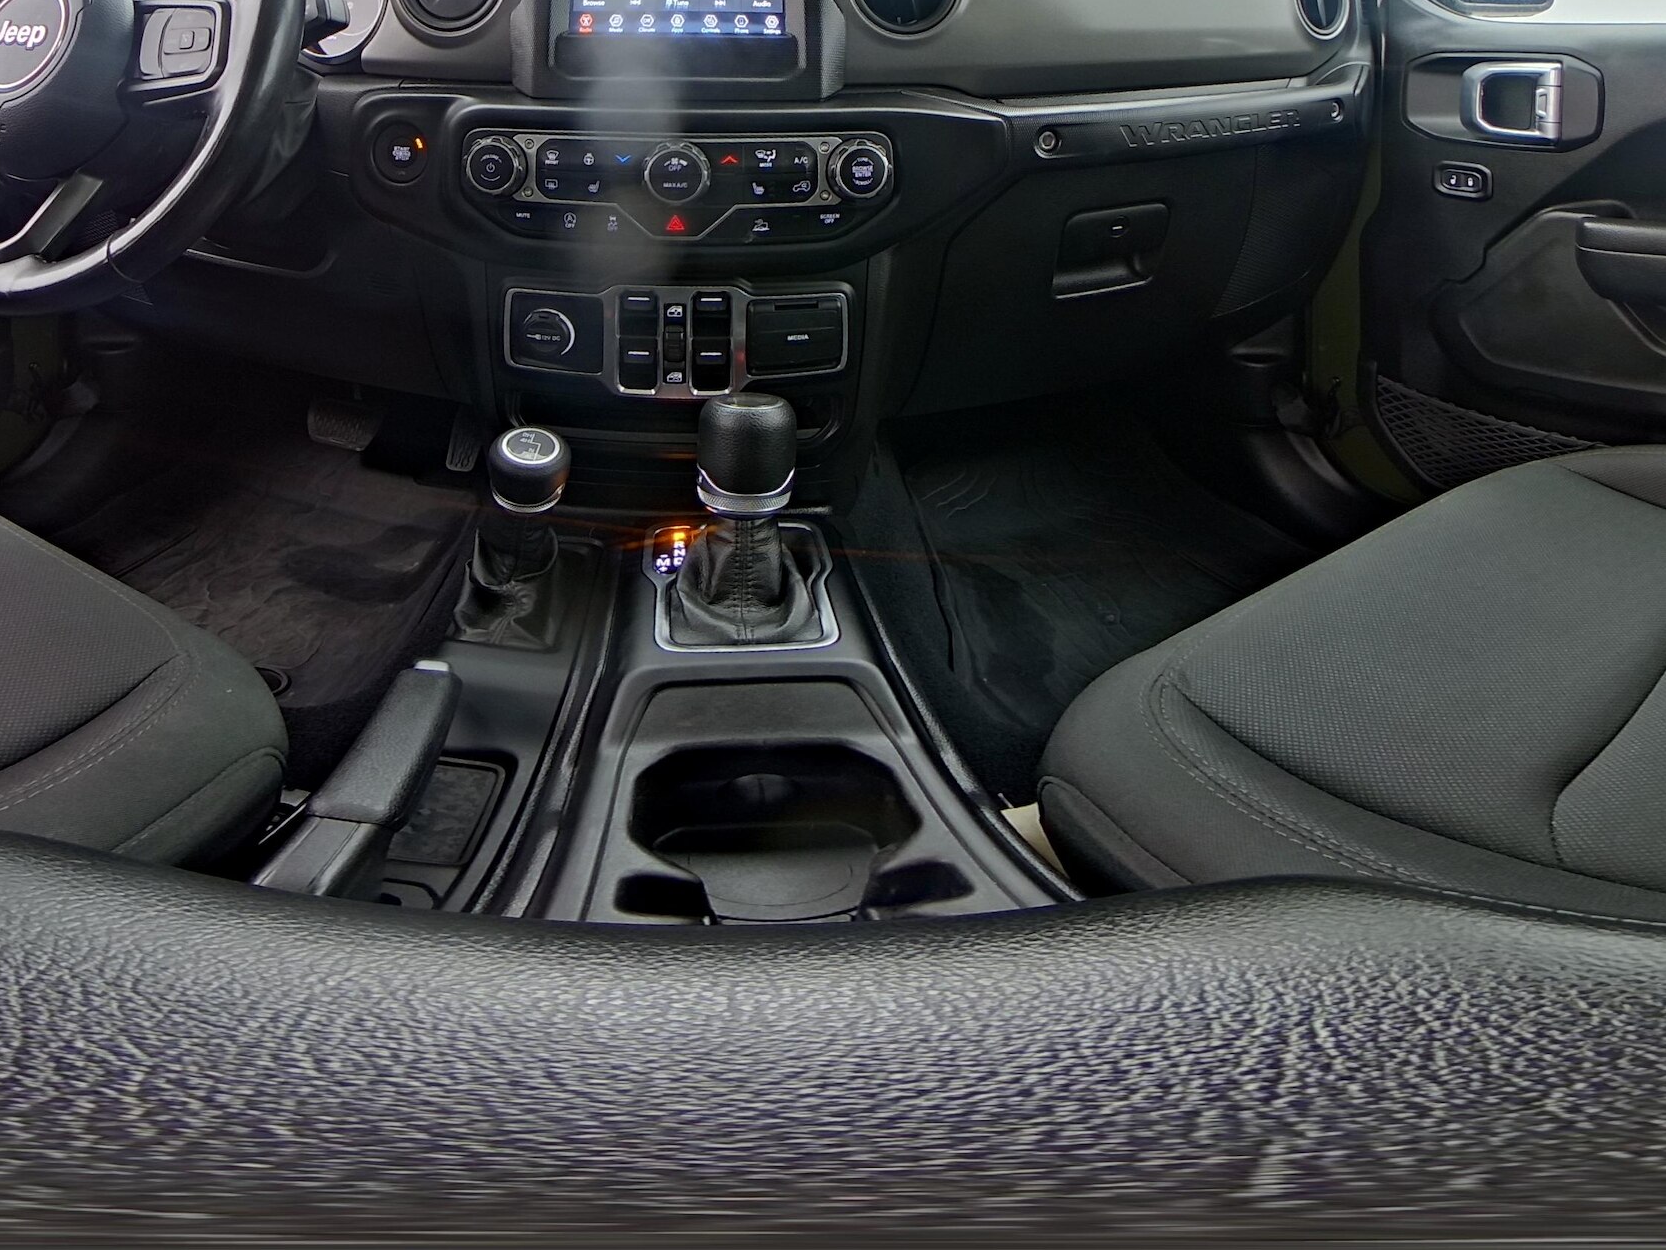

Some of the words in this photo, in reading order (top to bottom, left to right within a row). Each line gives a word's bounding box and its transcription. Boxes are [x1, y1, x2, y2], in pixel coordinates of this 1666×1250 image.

[673, 0, 690, 7] Tune
[1119, 108, 1301, 147] WRANGLER
[794, 156, 809, 165] A/C
[673, 548, 686, 557] N
[656, 558, 671, 566] M
